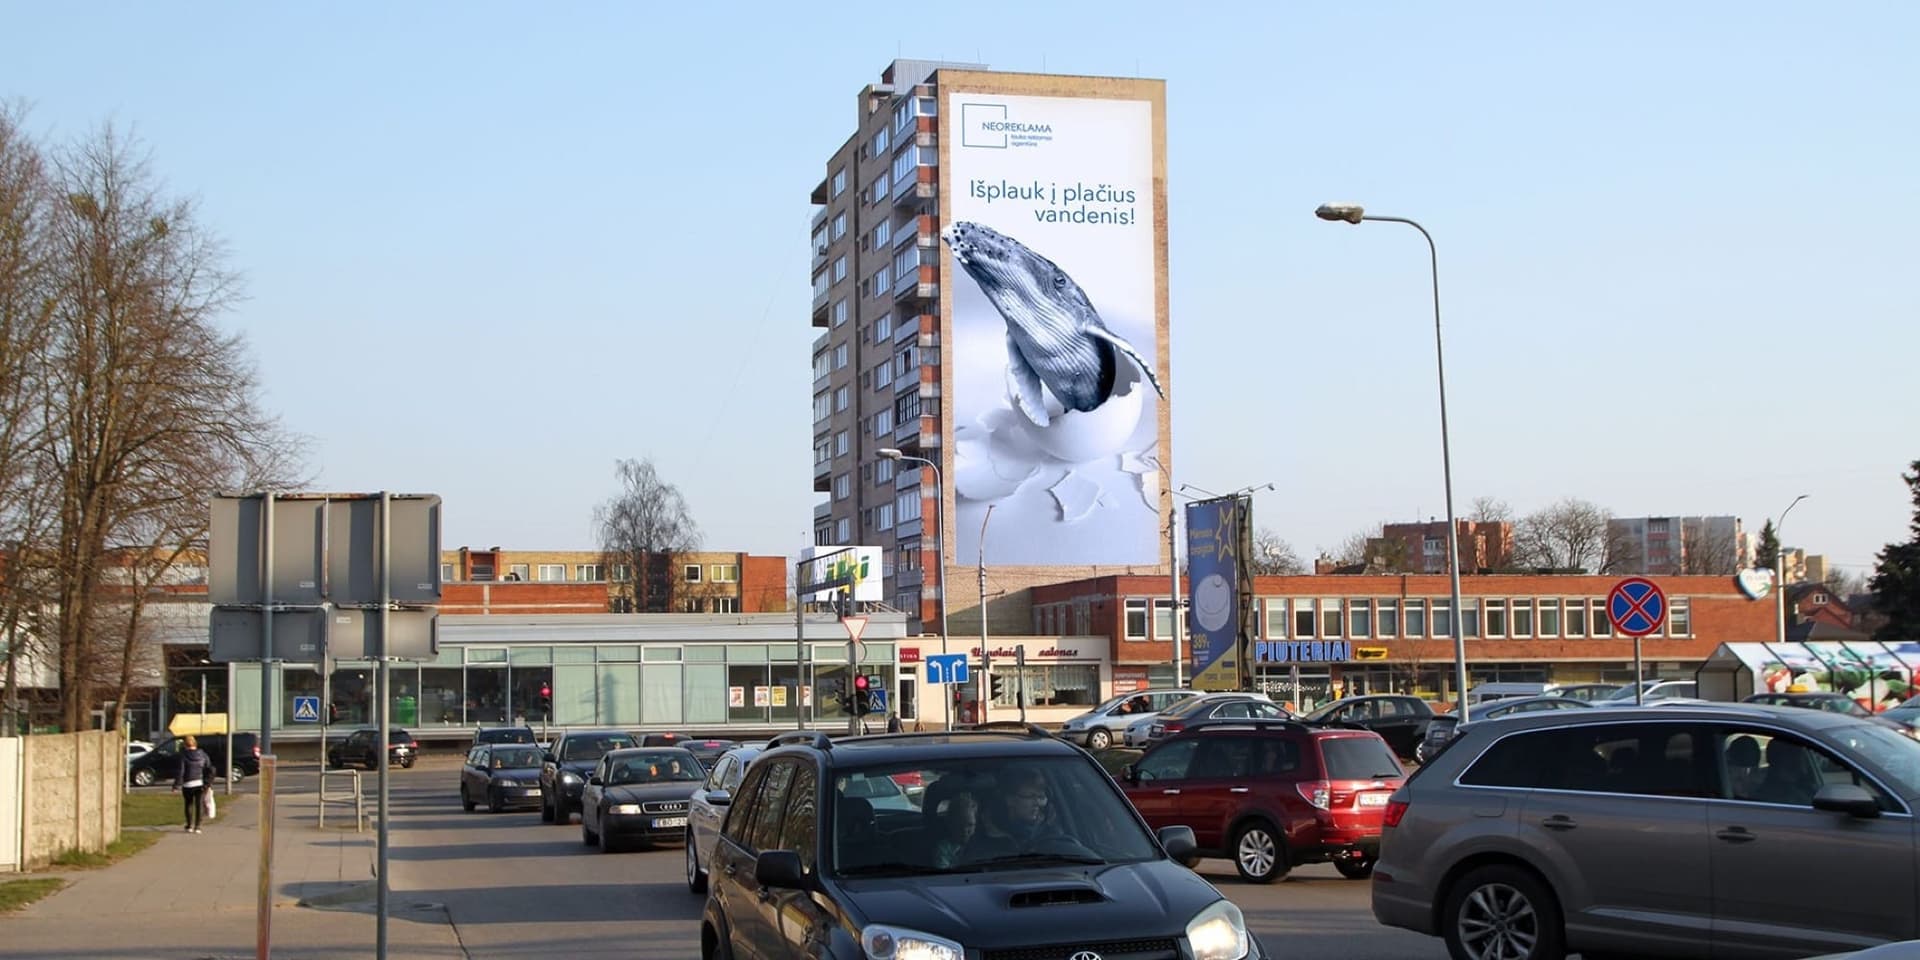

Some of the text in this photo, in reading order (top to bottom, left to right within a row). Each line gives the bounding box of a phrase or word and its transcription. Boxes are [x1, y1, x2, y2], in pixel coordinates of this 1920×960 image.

[981, 121, 1053, 133] NEOREKLAMA
[970, 180, 1136, 206] Išplauk į plačius
[1035, 205, 1135, 225] vandenis!
[1038, 647, 1078, 658] salonas
